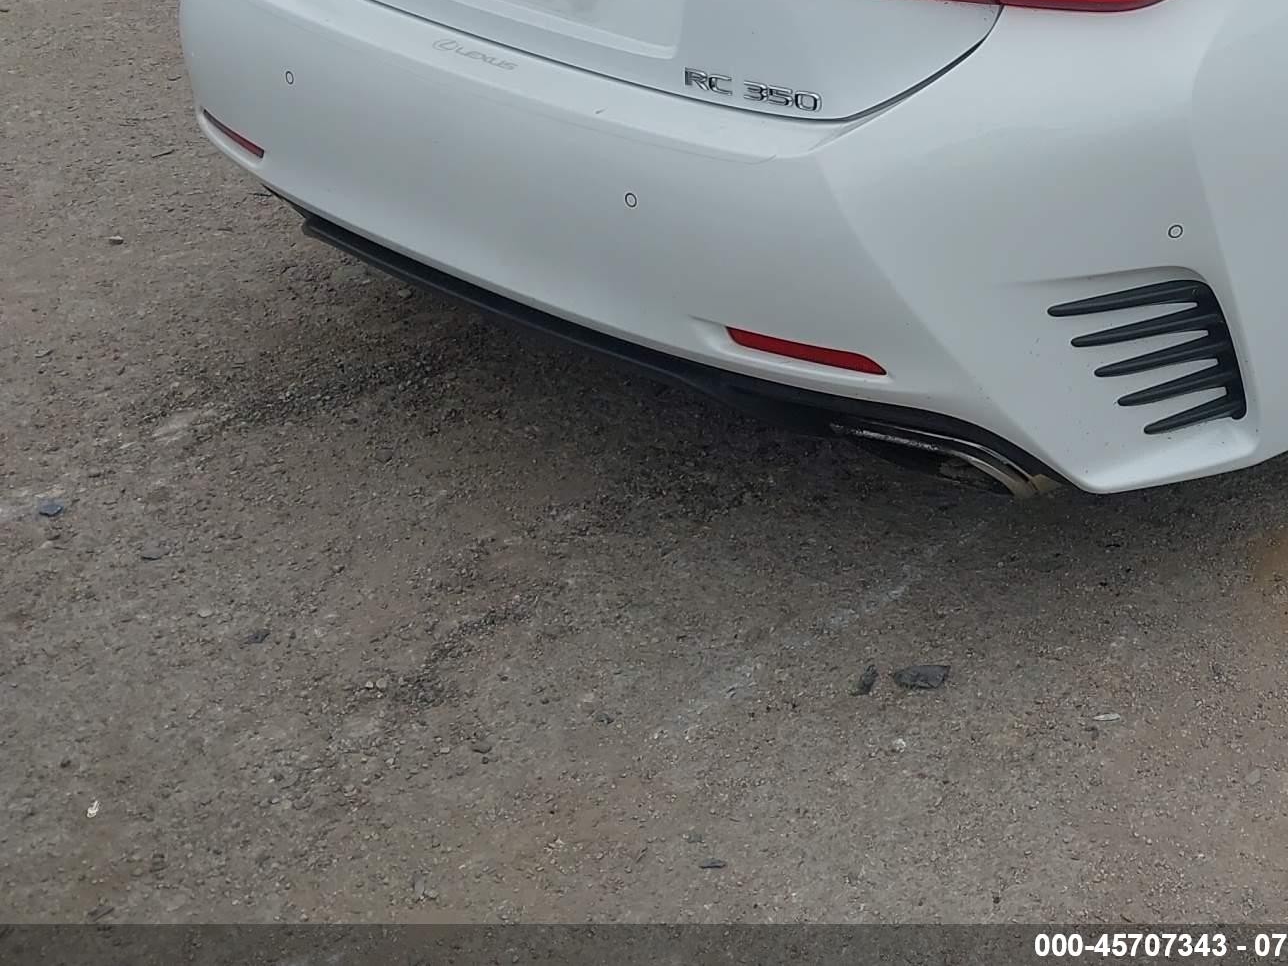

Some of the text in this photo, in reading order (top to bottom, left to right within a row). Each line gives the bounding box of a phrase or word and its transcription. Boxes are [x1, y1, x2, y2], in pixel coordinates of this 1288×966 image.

[455, 45, 519, 71] LEXUS
[684, 67, 823, 112] RC 350
